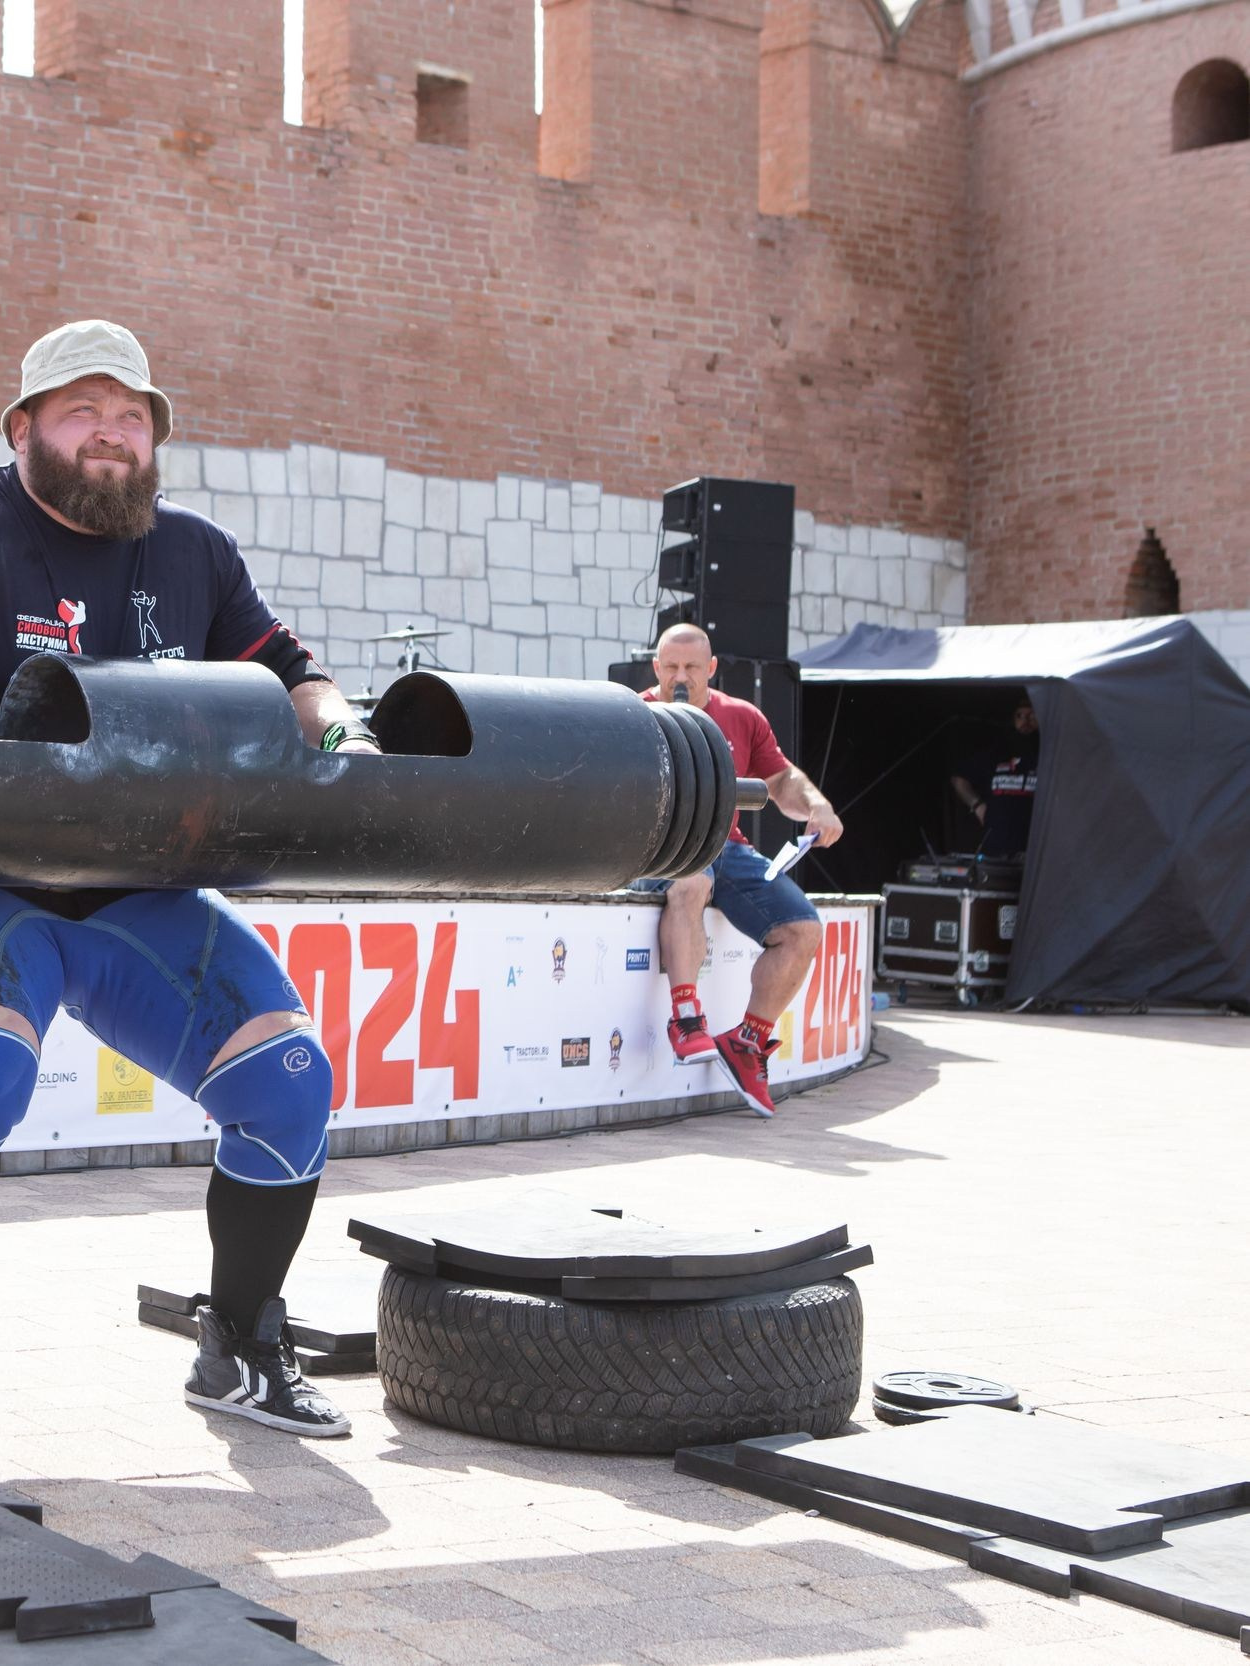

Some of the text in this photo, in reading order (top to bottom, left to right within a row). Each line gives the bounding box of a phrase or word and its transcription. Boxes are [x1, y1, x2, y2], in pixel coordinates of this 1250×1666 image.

[16, 614, 66, 629] ФЕДЕРАЦИЯ
[17, 621, 66, 639] СИЛОВОГО
[16, 632, 68, 651] ЭКСТРИМА
[562, 1043, 589, 1059] UNCS
[38, 1072, 78, 1084] OLDING
